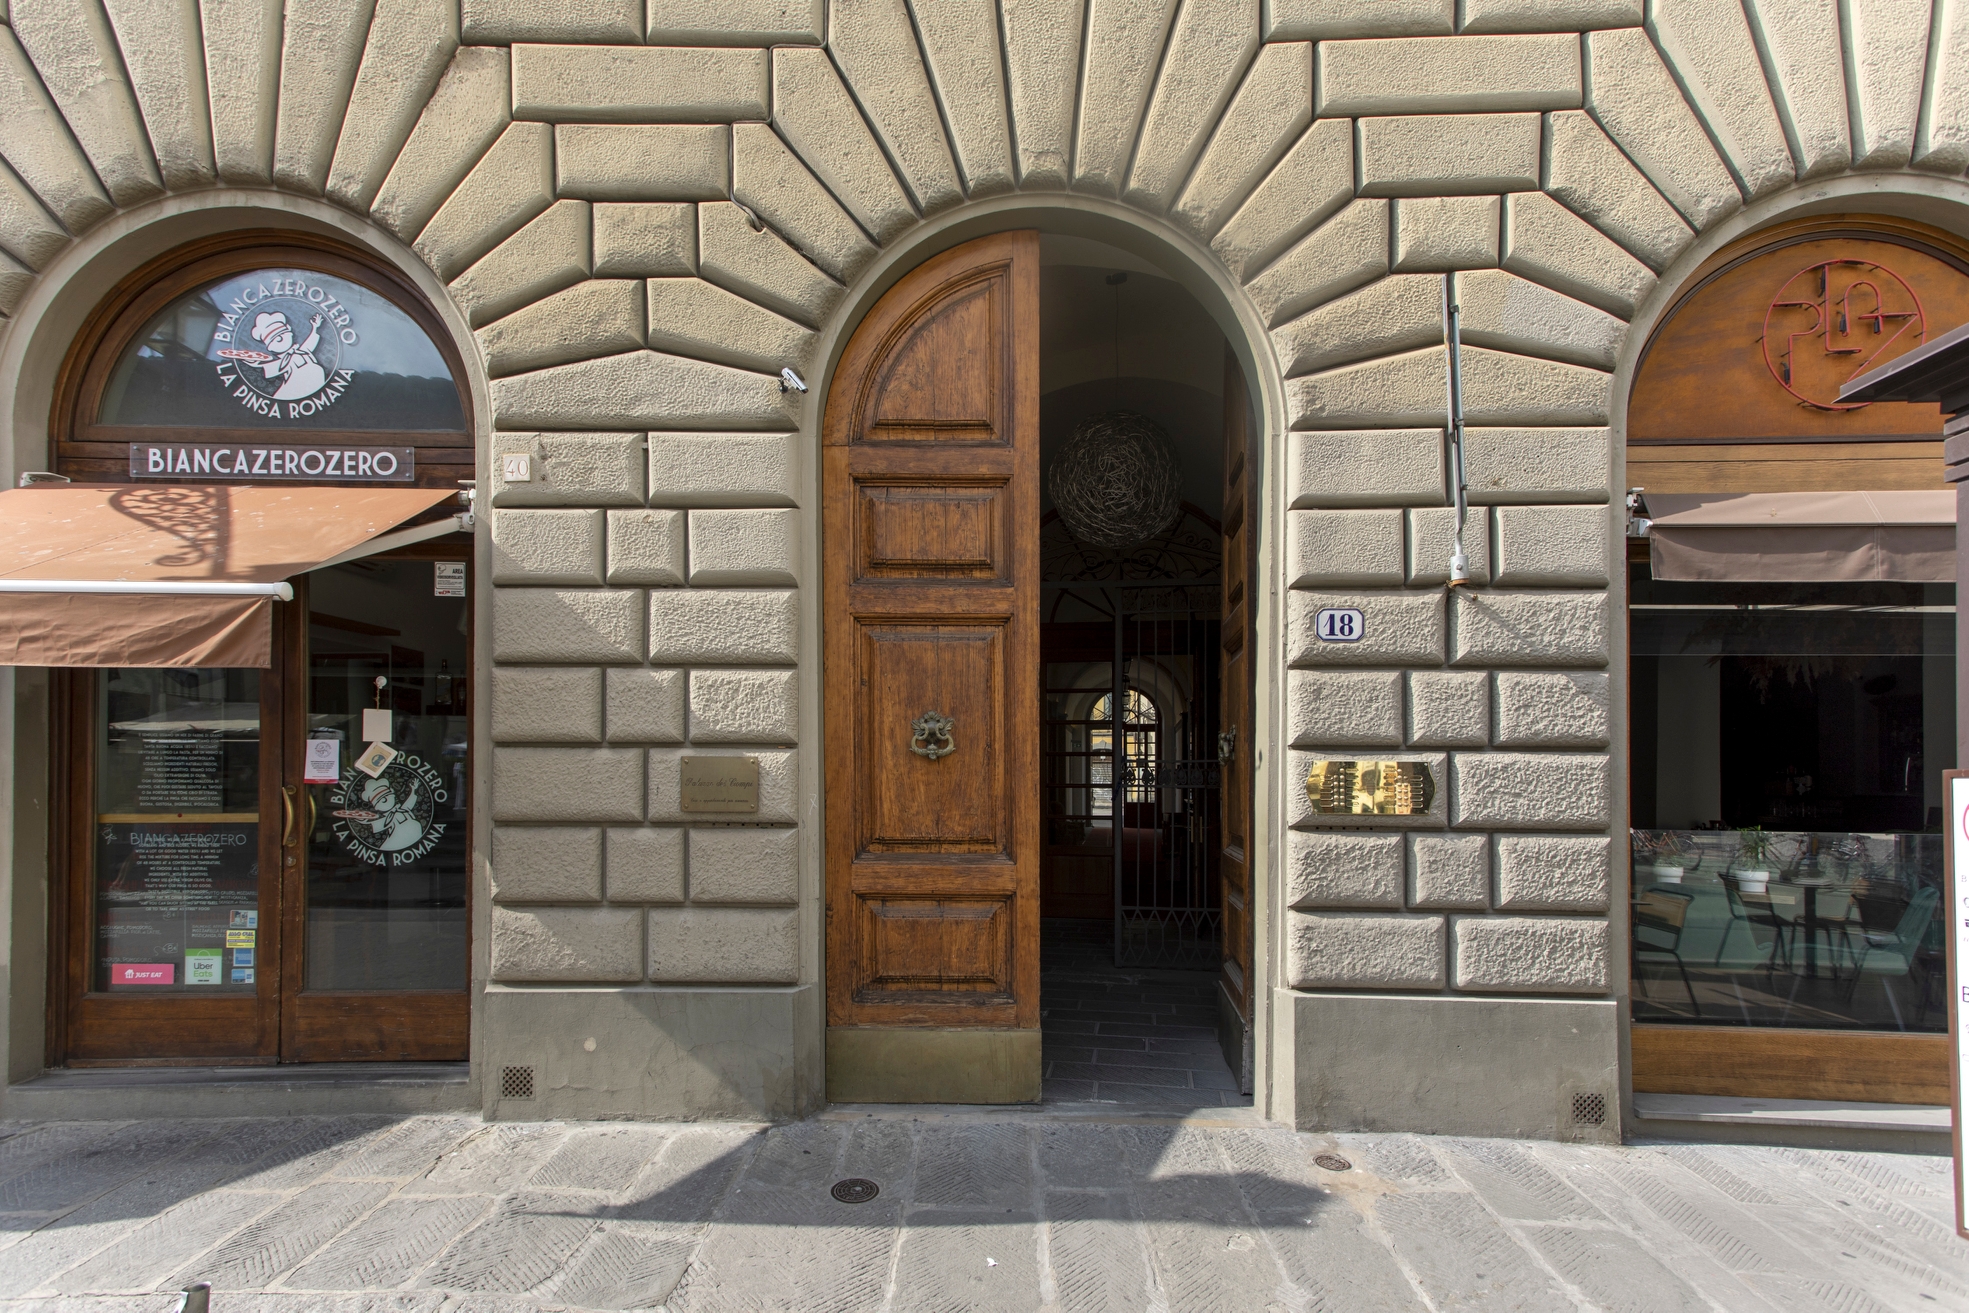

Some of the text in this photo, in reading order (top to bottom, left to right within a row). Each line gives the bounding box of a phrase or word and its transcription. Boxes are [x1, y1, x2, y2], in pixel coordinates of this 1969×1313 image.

[214, 279, 356, 344] BIANCAZEROZERO
[216, 362, 355, 419] LA PINSA ROMANA
[147, 447, 398, 476] BIANCAZEROZERO
[506, 459, 528, 477] 40
[1323, 613, 1354, 637] 18
[130, 832, 247, 846] BIANCAZEROZERO
[332, 820, 447, 866] LA PINSA ROMANA
